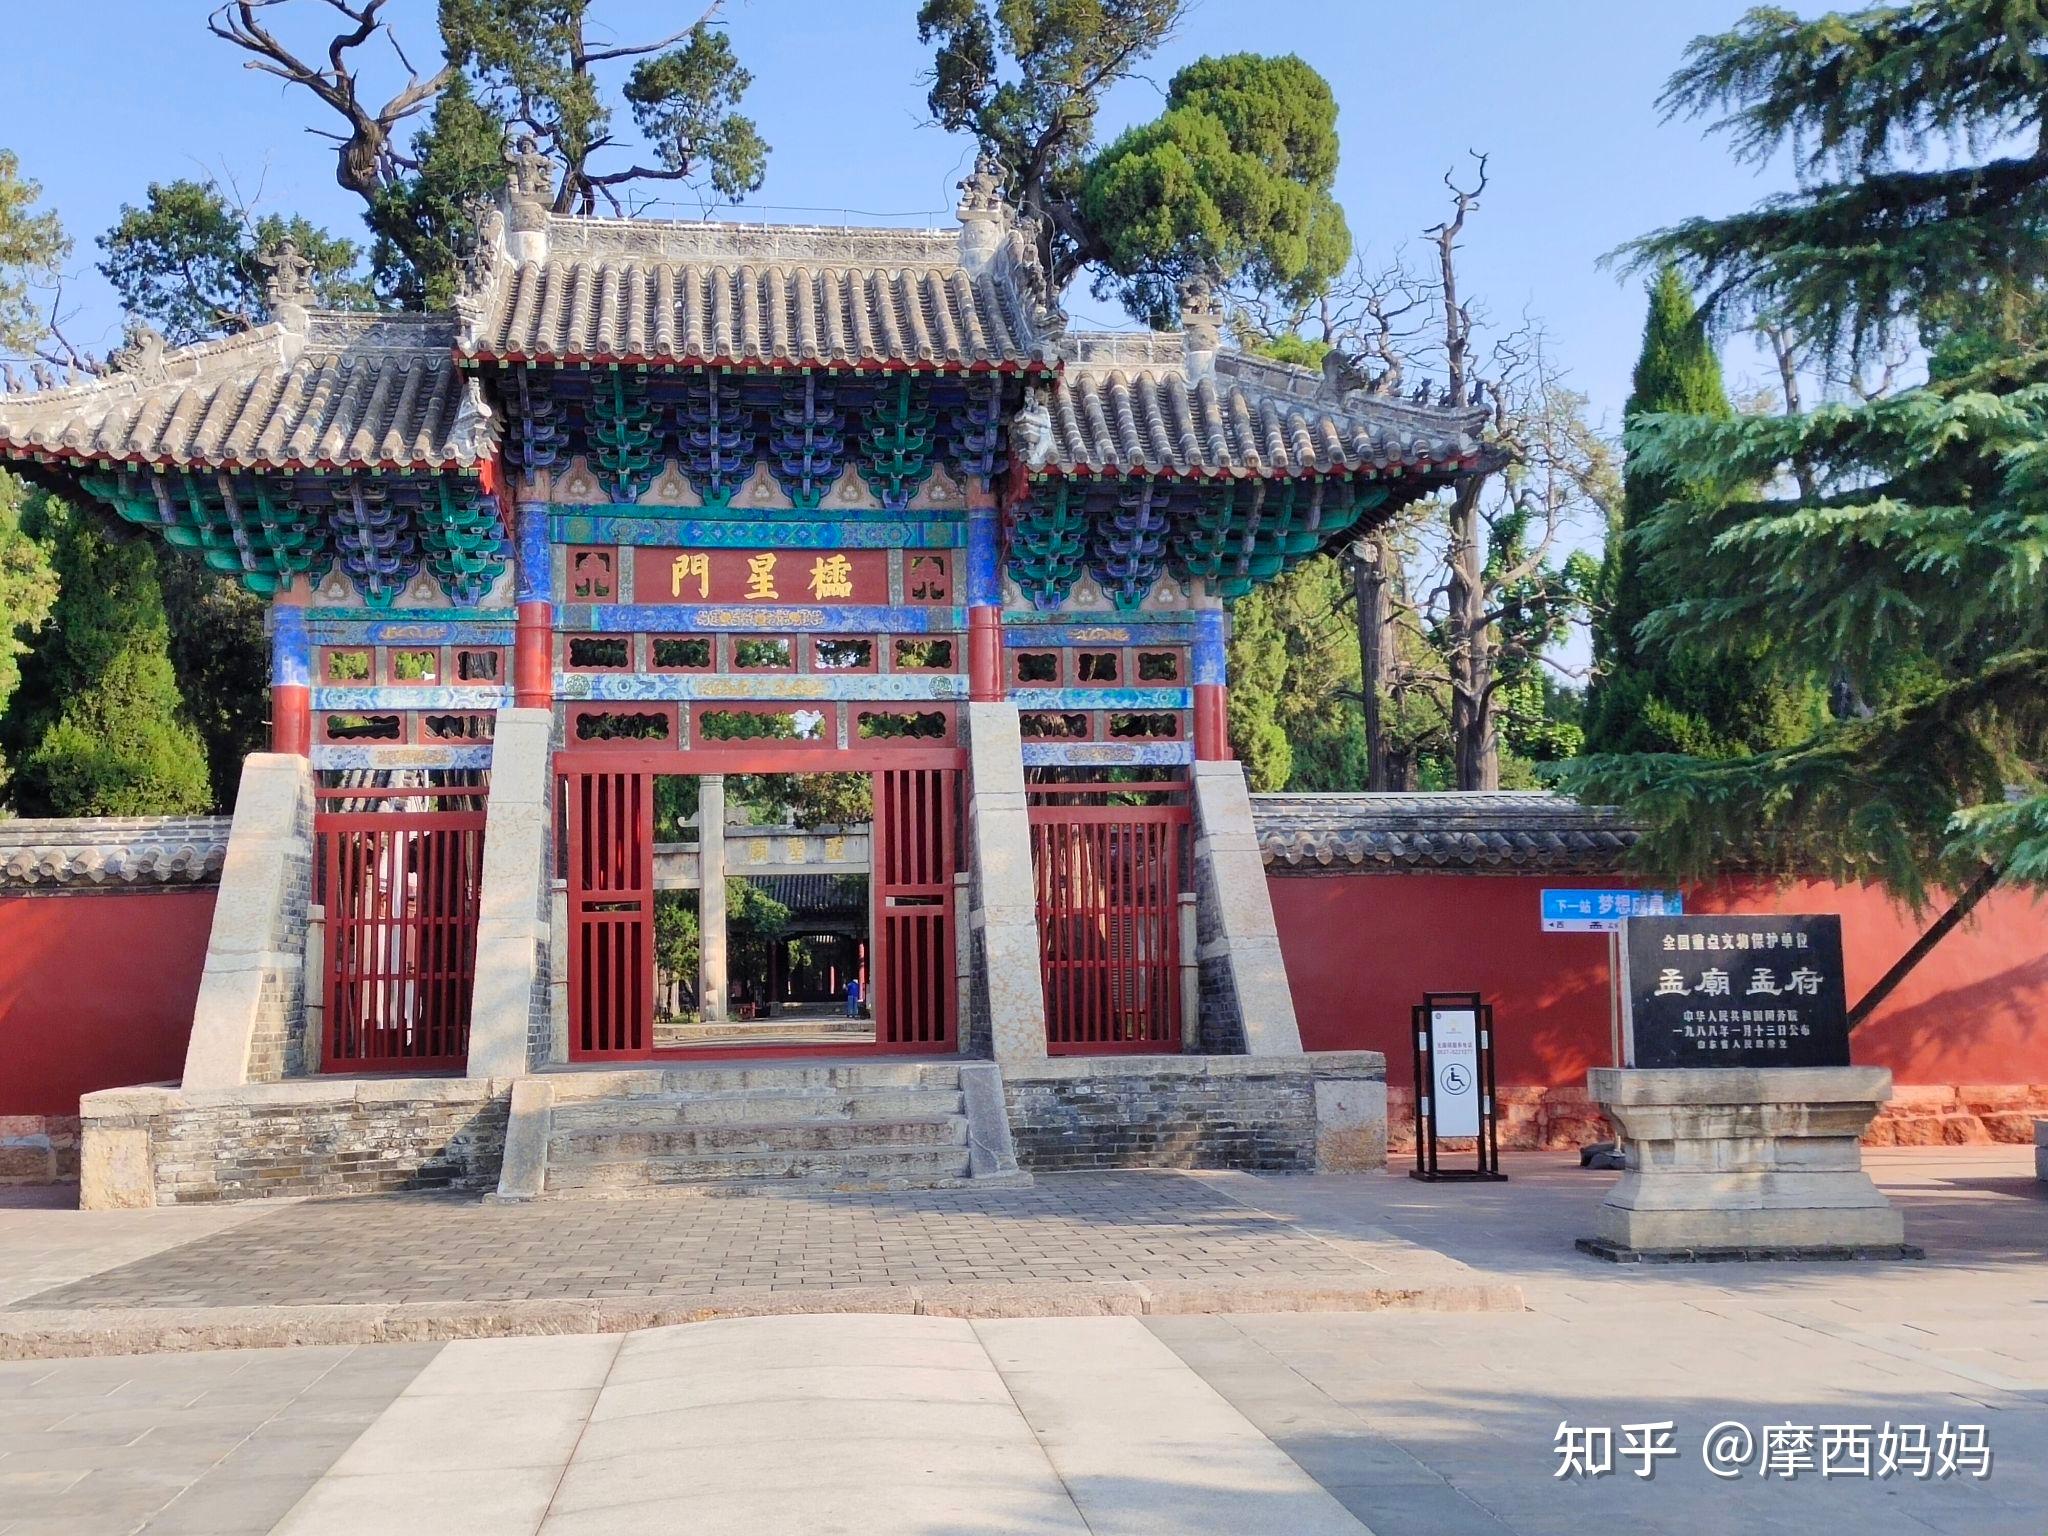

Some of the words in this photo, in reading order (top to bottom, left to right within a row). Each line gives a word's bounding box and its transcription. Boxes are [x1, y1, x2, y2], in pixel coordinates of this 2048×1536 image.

[1556, 899, 1591, 914] 下一站
[1662, 932, 1808, 951] 全国重点文物保护单位
[1746, 966, 1824, 996] 孟府
[1683, 1009, 1798, 1022] 中华人民共和国国务院
[1673, 1024, 1810, 1037] 一九八八年一月十三日公布
